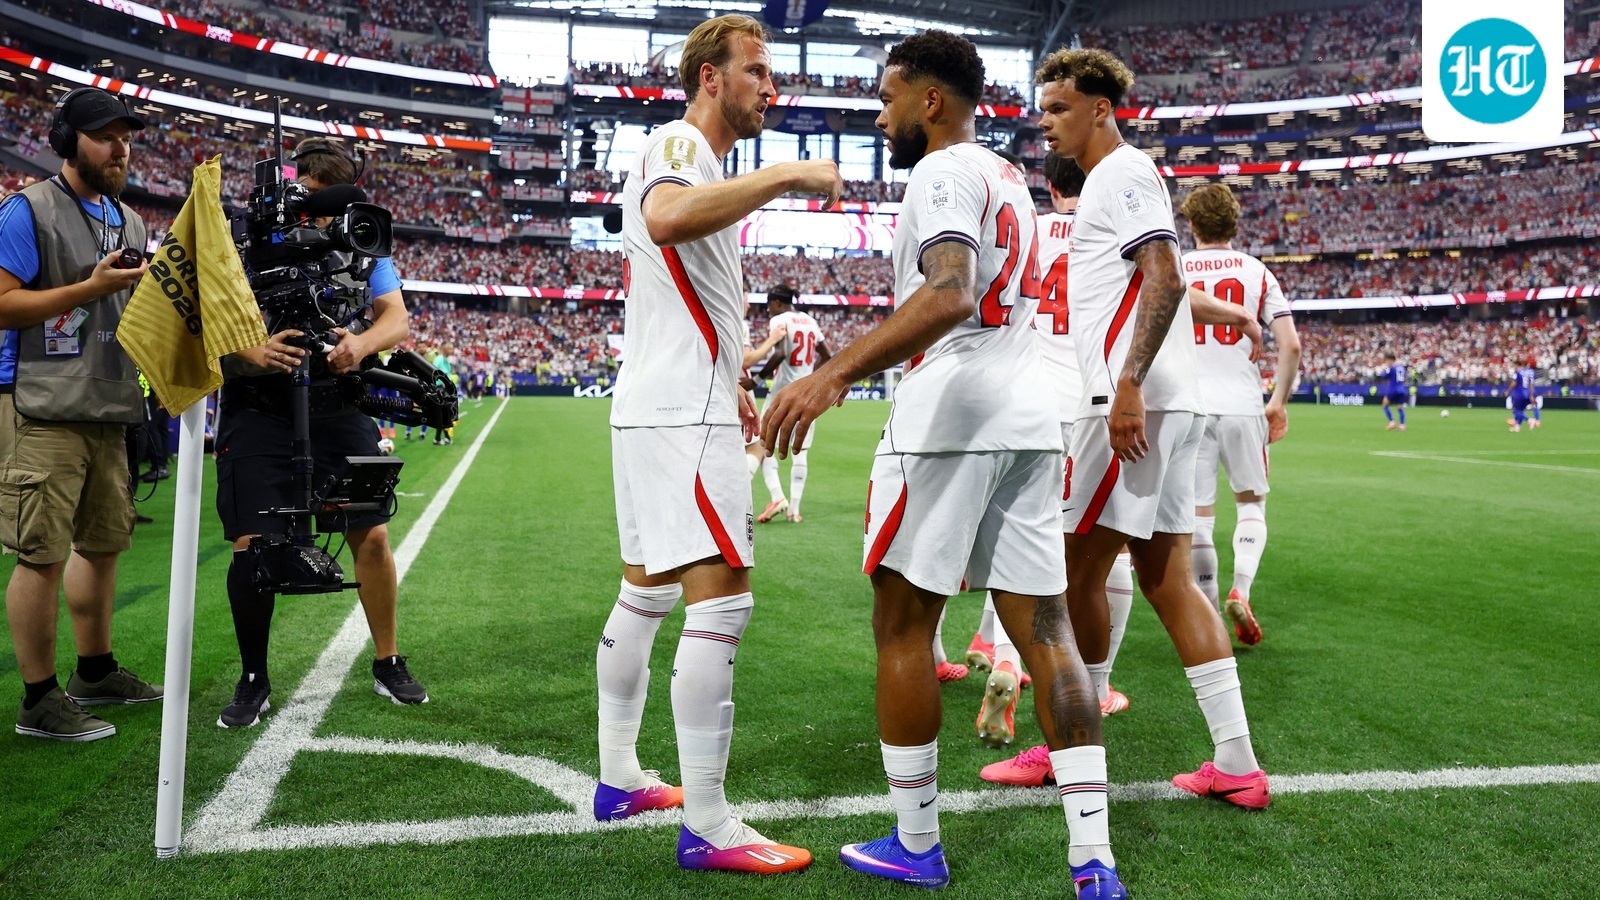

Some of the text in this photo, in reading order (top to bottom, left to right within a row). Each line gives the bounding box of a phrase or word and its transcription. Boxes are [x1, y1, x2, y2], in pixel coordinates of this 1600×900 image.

[1185, 258, 1243, 272] GORDON
[149, 260, 203, 336] 2026
[1037, 253, 1069, 335] 4
[1328, 392, 1365, 406] Telluride
[683, 844, 708, 855] SKX
